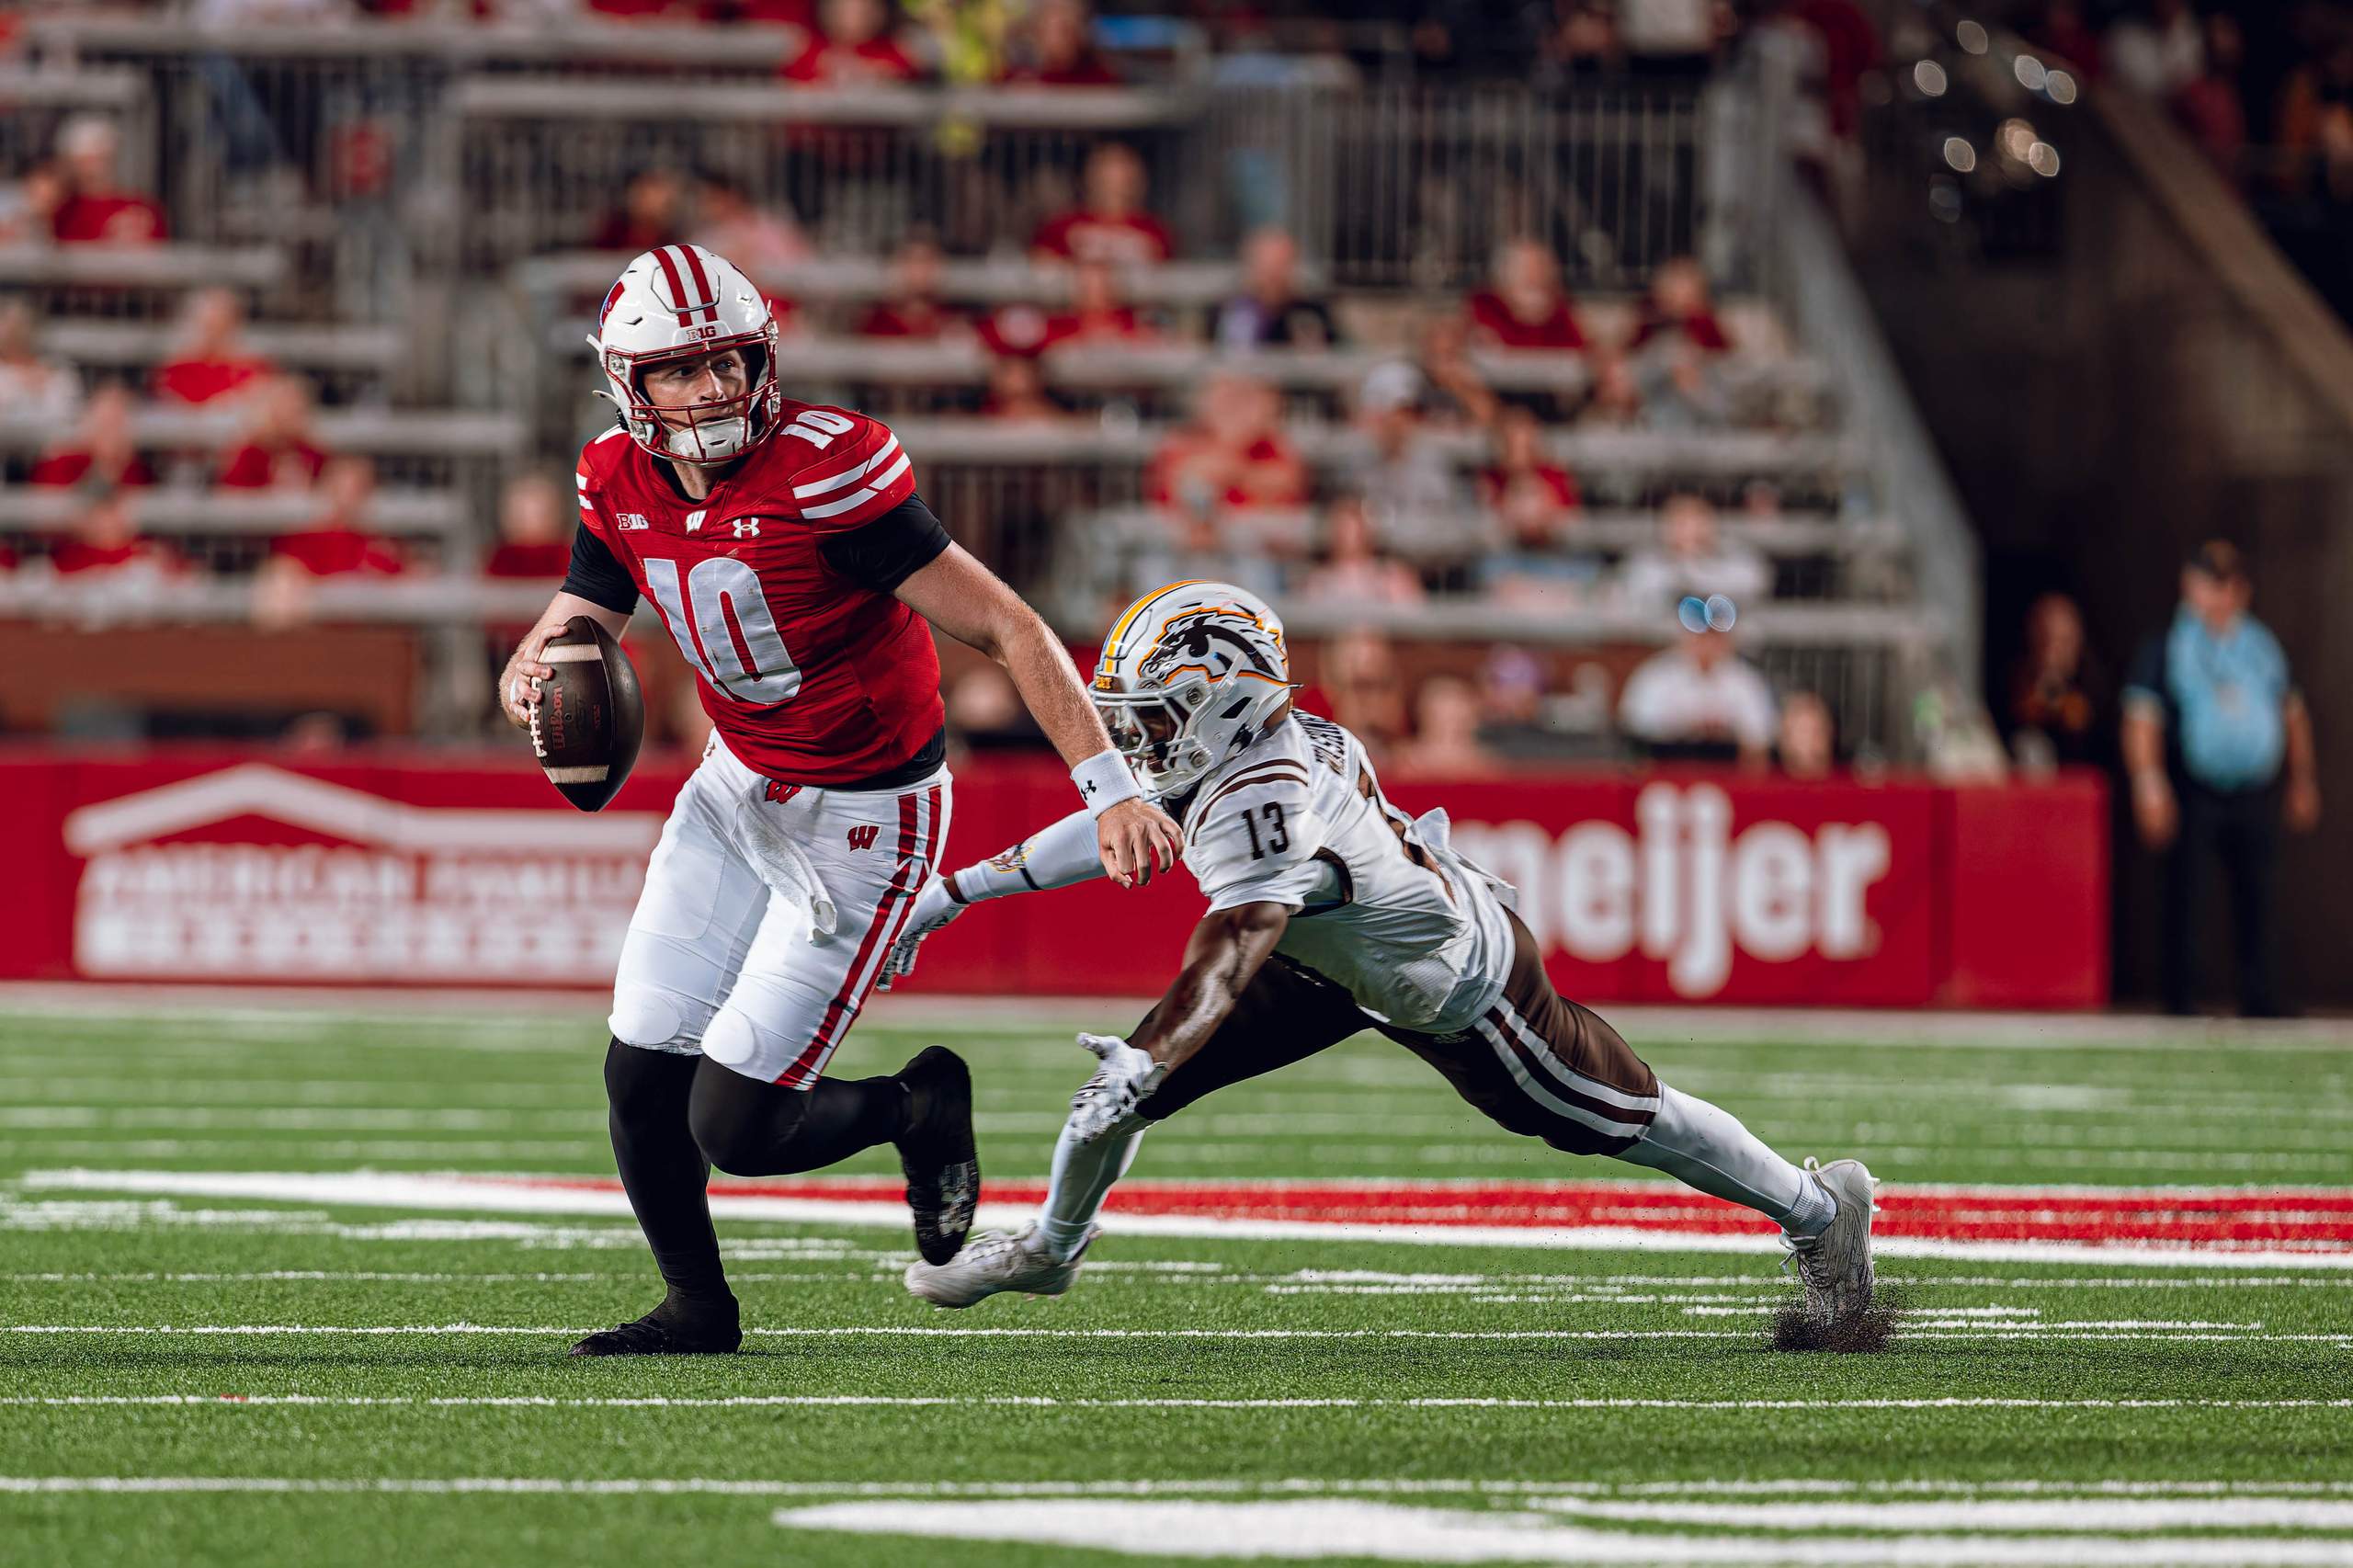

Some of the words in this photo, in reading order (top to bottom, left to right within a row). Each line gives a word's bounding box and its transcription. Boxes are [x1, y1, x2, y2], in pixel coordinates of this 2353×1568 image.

[779, 410, 855, 450] 10
[643, 557, 802, 706] 10
[1241, 801, 1290, 860] 13
